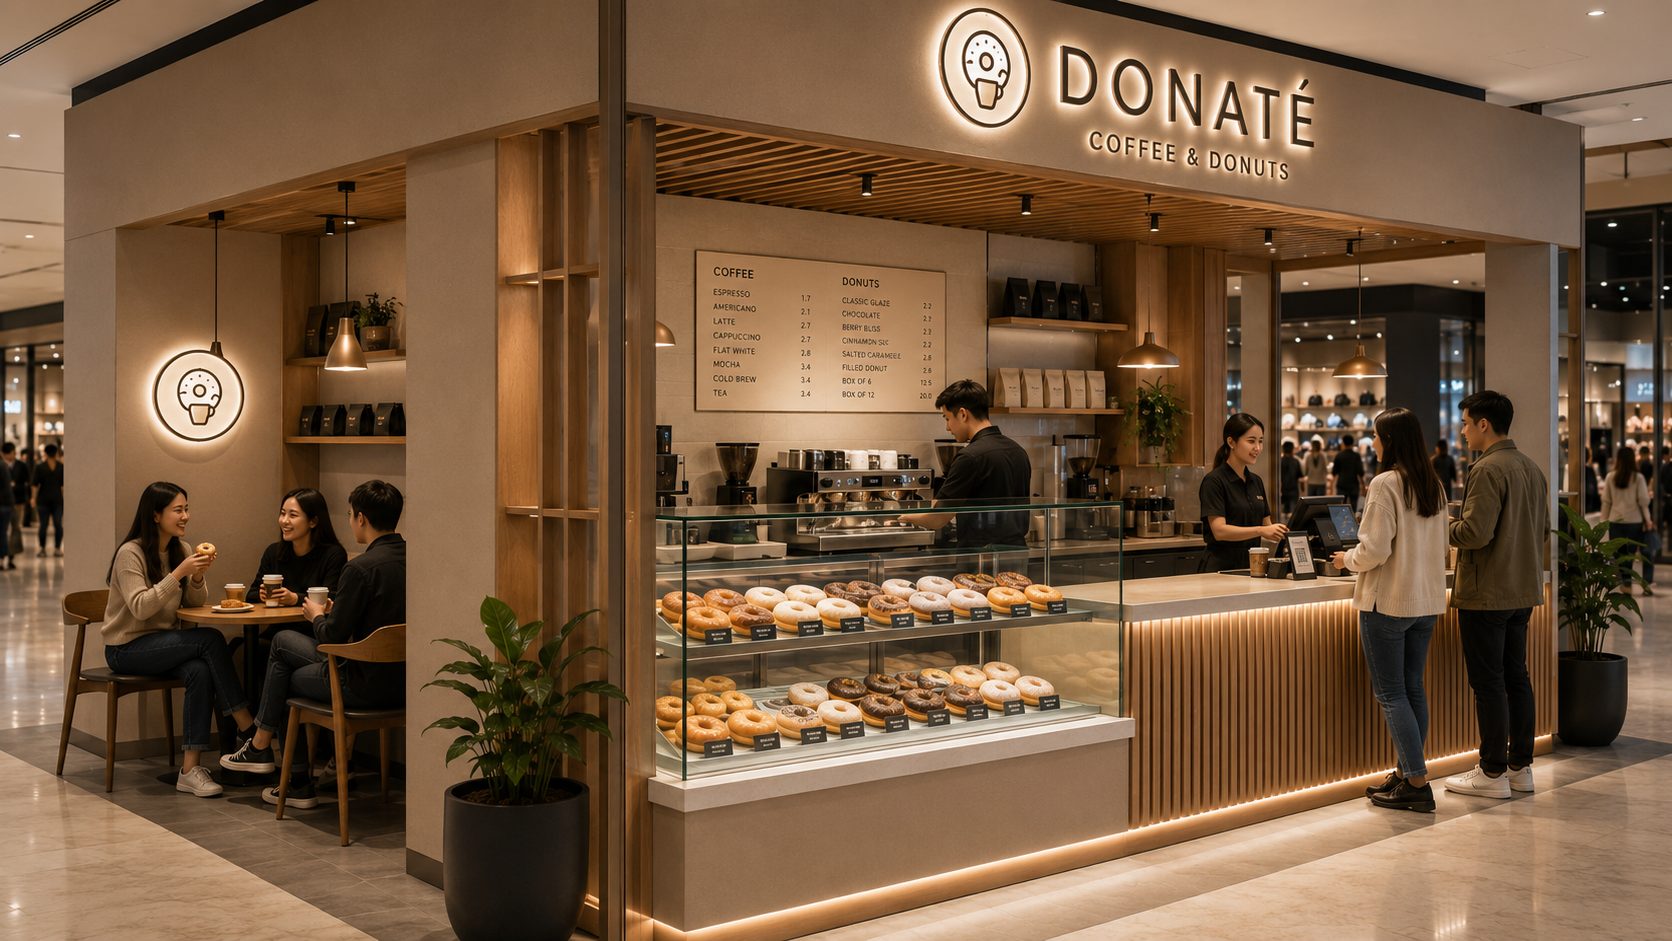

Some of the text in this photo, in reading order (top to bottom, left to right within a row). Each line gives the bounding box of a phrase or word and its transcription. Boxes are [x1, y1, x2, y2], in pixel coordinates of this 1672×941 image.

[1060, 45, 1315, 148] DONATÉ
[1089, 131, 1289, 180] COFFEE & DONUTS
[713, 266, 754, 279] COFFEE
[842, 277, 880, 288] DONUTS
[713, 288, 811, 302] ESPRESSO 1.7
[841, 297, 869, 306] CLASSIC
[713, 303, 757, 312] AMERICANO
[841, 310, 880, 319] CHOCOLATE
[713, 318, 736, 326] LATTE
[842, 323, 862, 331] BERRY
[713, 331, 761, 341] CAPPUCCINO
[713, 346, 730, 354] FLAT
[732, 347, 756, 355] WHITE
[842, 350, 866, 358] SALTED
[713, 360, 741, 368] MOCHA
[842, 364, 863, 372] FILLED
[865, 364, 888, 372] DONUT
[713, 374, 734, 383] COLD
[735, 375, 757, 383] BREW
[842, 377, 856, 385] BOX
[857, 377, 866, 385] OF
[713, 389, 728, 397] TEA
[842, 390, 856, 398] BOX
